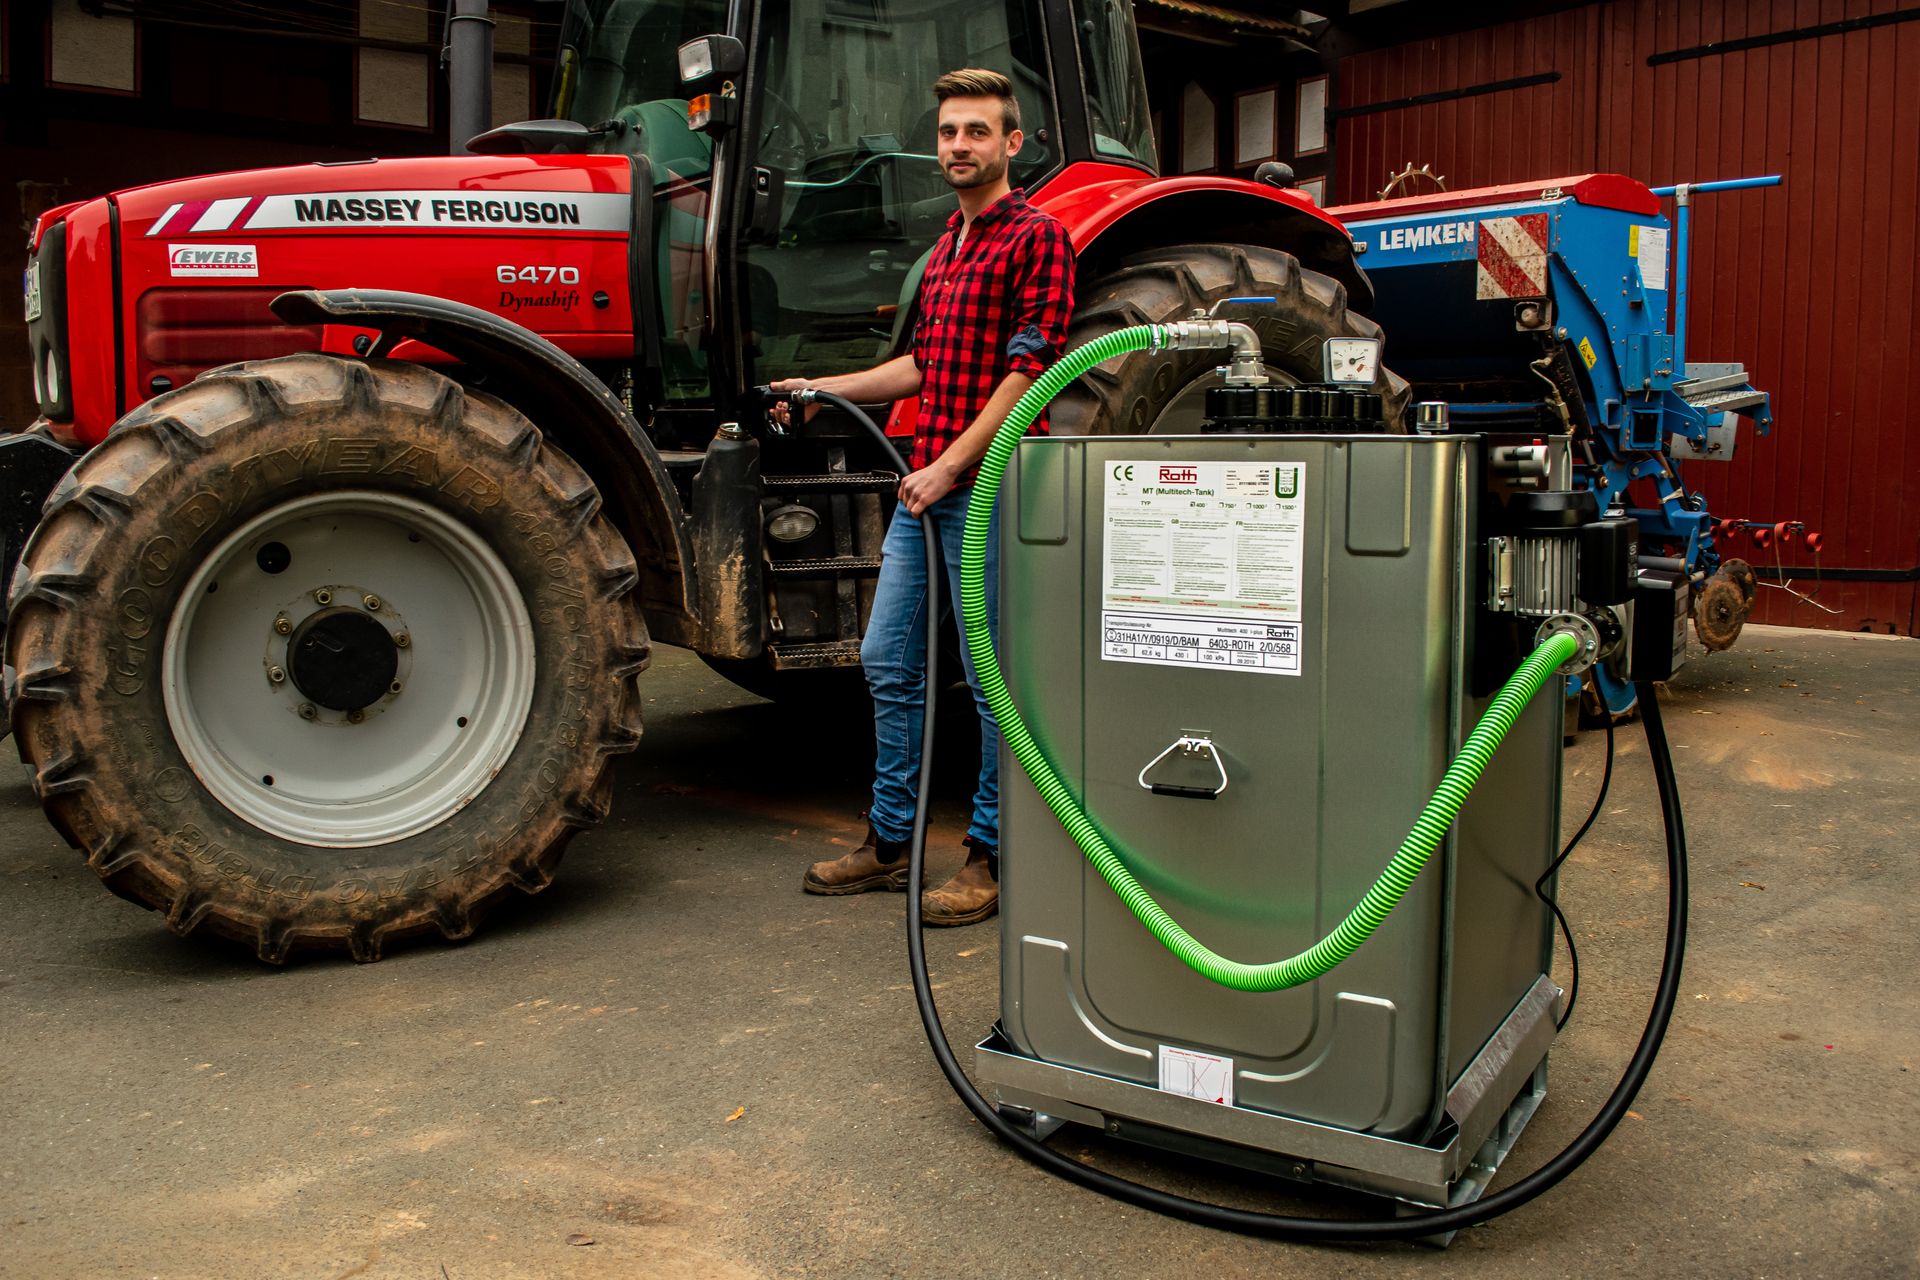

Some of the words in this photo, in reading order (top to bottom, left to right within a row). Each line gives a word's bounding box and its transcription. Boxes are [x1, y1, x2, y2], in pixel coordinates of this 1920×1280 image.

[295, 199, 421, 222] MASSEY
[432, 199, 580, 225] FERGUSON
[1380, 221, 1475, 253] LEMKEN
[180, 250, 253, 264] EWERS
[496, 265, 580, 285] 6470
[500, 291, 580, 314] Dynashift
[1159, 468, 1198, 481] Roth
[1142, 487, 1154, 495] MT
[1155, 487, 1215, 497] (Multitech-Tank)
[1116, 631, 1200, 646] 31HA1/Y/0919/D/BAM
[1208, 638, 1255, 651] 6403-ROTH
[1259, 641, 1291, 653] 2/0/568
[1266, 628, 1294, 638] Roth
